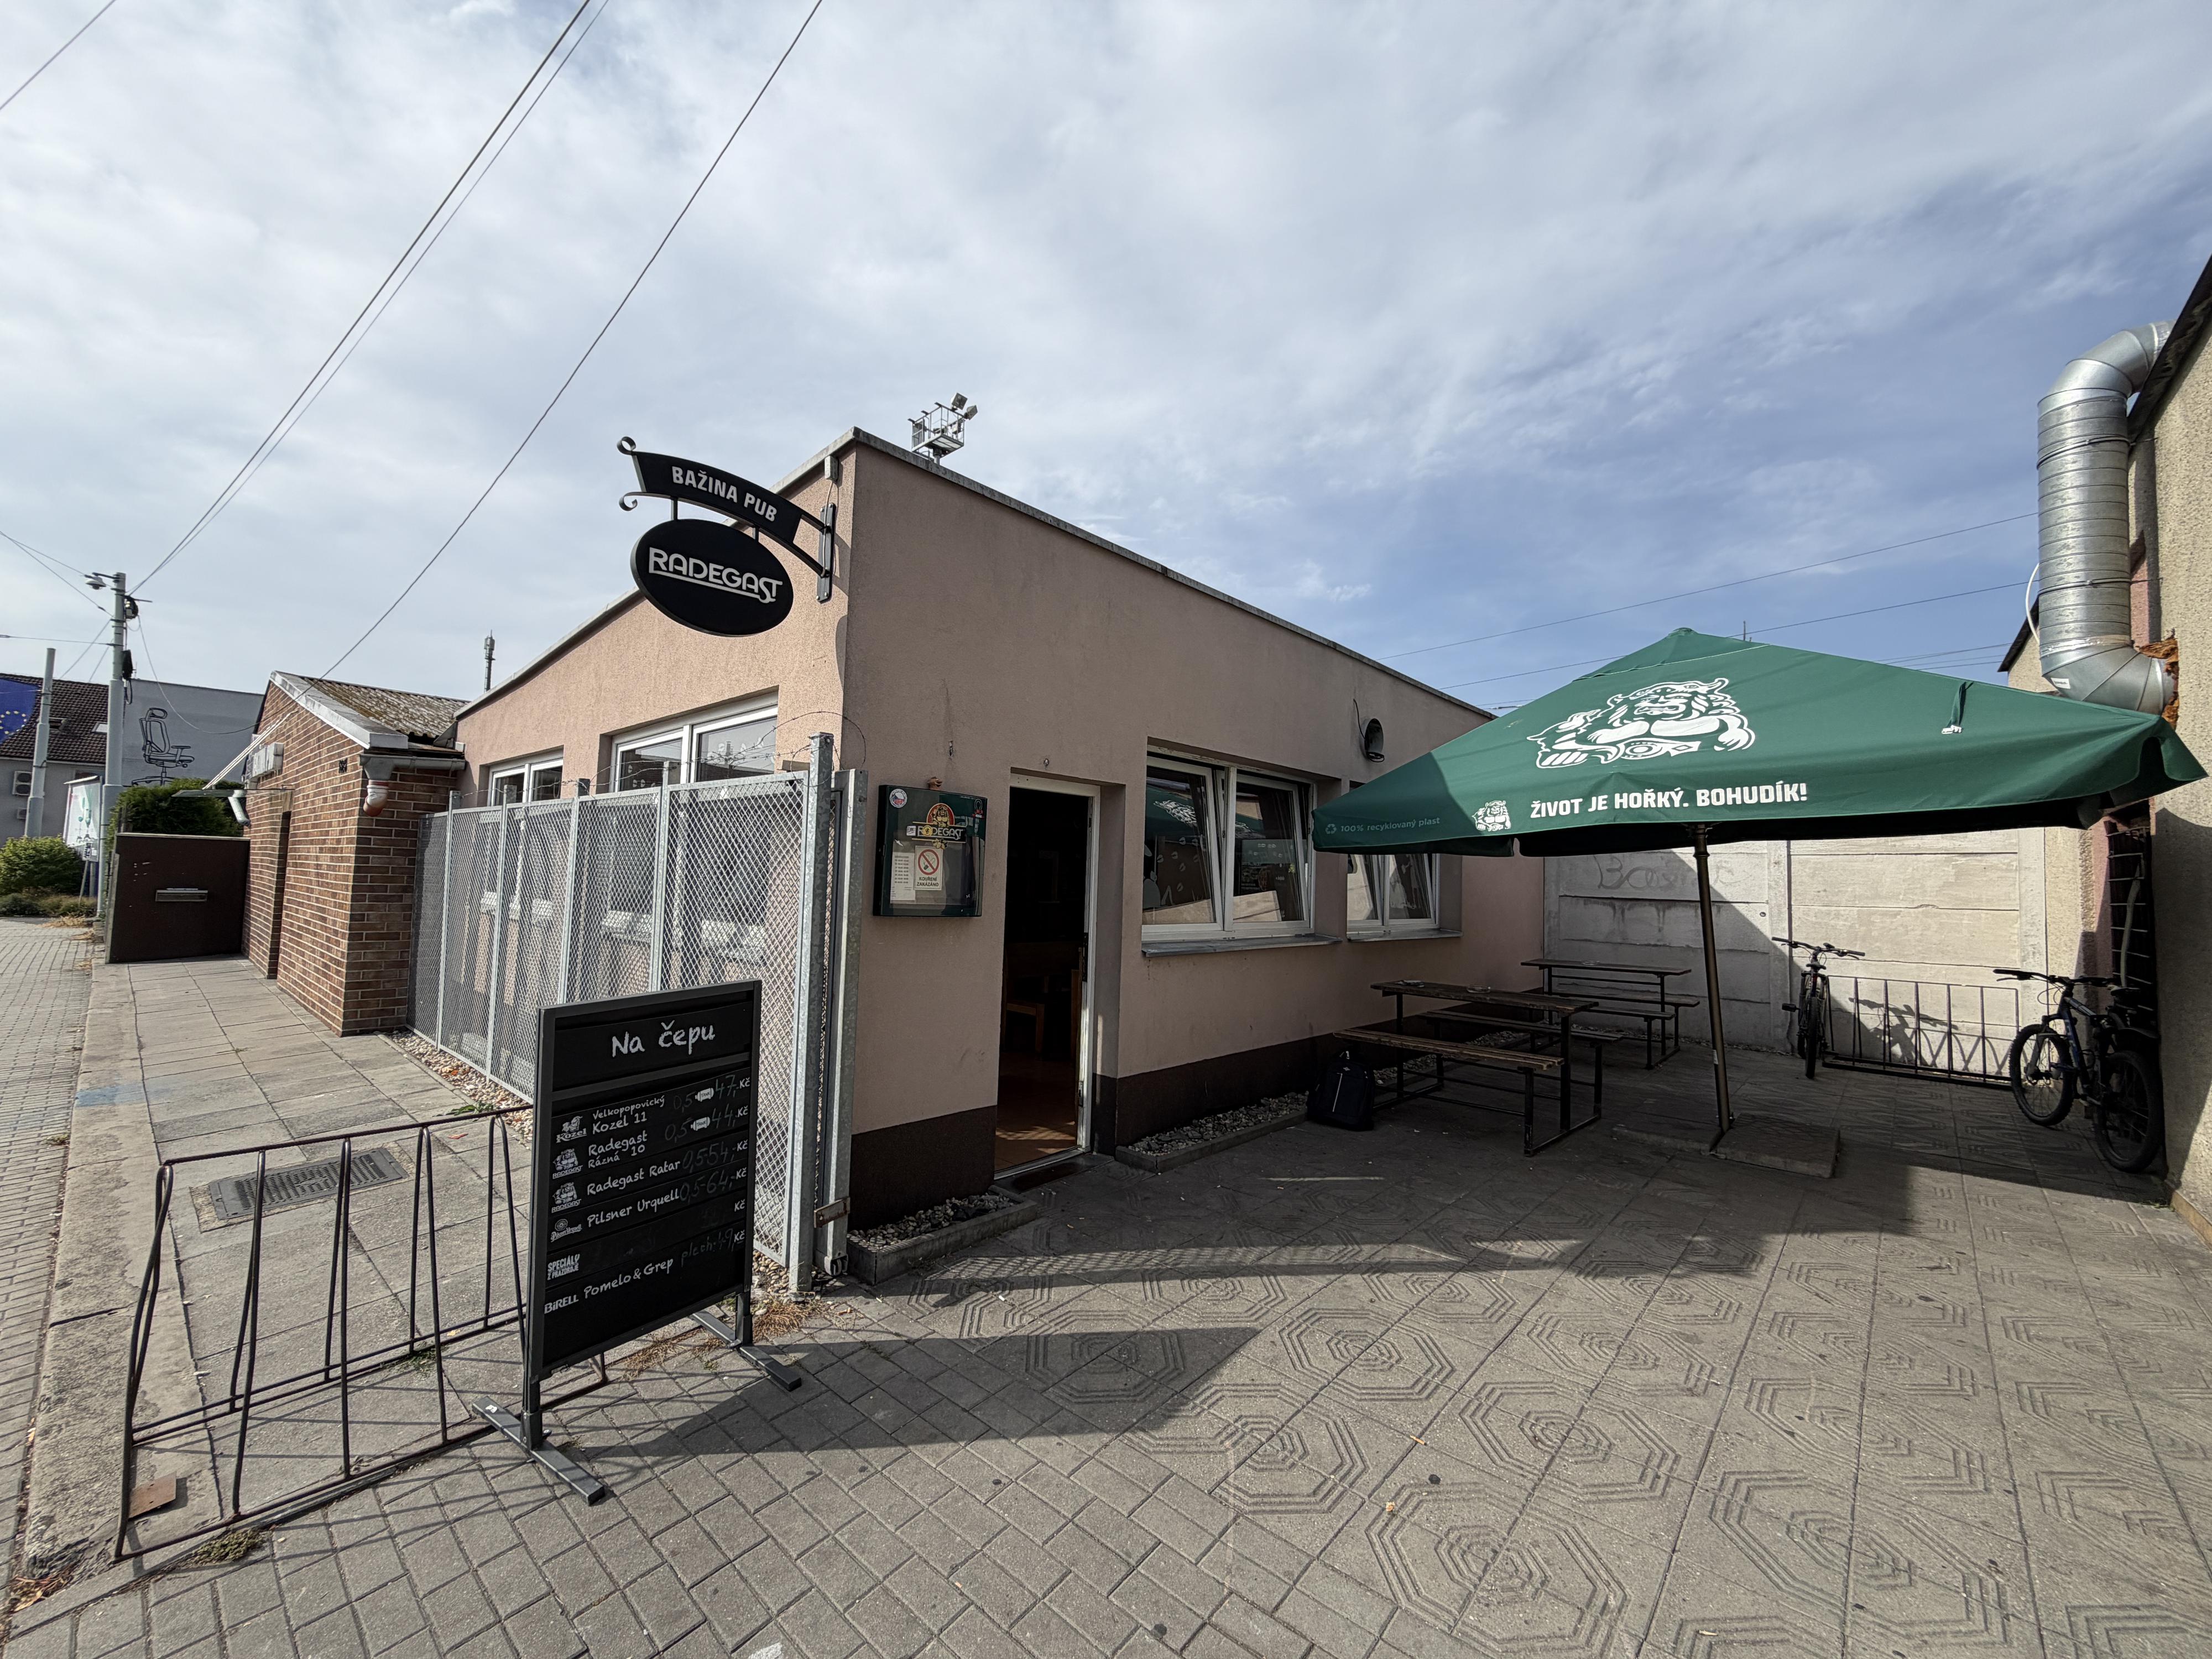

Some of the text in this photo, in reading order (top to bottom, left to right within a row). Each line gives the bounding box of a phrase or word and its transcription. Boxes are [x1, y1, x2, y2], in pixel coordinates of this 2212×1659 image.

[671, 466, 778, 522] BAŽINA PUB
[649, 547, 782, 603] RADEGAST
[1530, 780, 1808, 818] ŽIVOT JE HOŘKÝ. BOHUDÍK!
[917, 826, 964, 841] RDEGAST
[1367, 820, 1416, 832] recyklovaný
[1418, 817, 1441, 827] plast
[611, 1019, 716, 1058] Na čepu
[592, 1095, 665, 1120] Velkopopovický
[739, 1077, 750, 1089] Kč
[556, 1128, 587, 1143] Kozel
[588, 1130, 648, 1156] Radegast
[737, 1105, 749, 1118] Kč
[592, 1112, 648, 1135] Kozel 11
[587, 1168, 645, 1196] Radegast
[649, 1160, 681, 1177] Ratar
[737, 1139, 748, 1152] Kč
[588, 1144, 646, 1168] Rázná 10
[587, 1206, 633, 1228] Pilsner
[637, 1188, 680, 1212] Urquell
[735, 1167, 747, 1180] Kč
[734, 1198, 745, 1212] Kč
[583, 1274, 632, 1299] Pomelo
[633, 1268, 642, 1280] &
[643, 1259, 674, 1275] Grep
[734, 1229, 745, 1243] Kč
